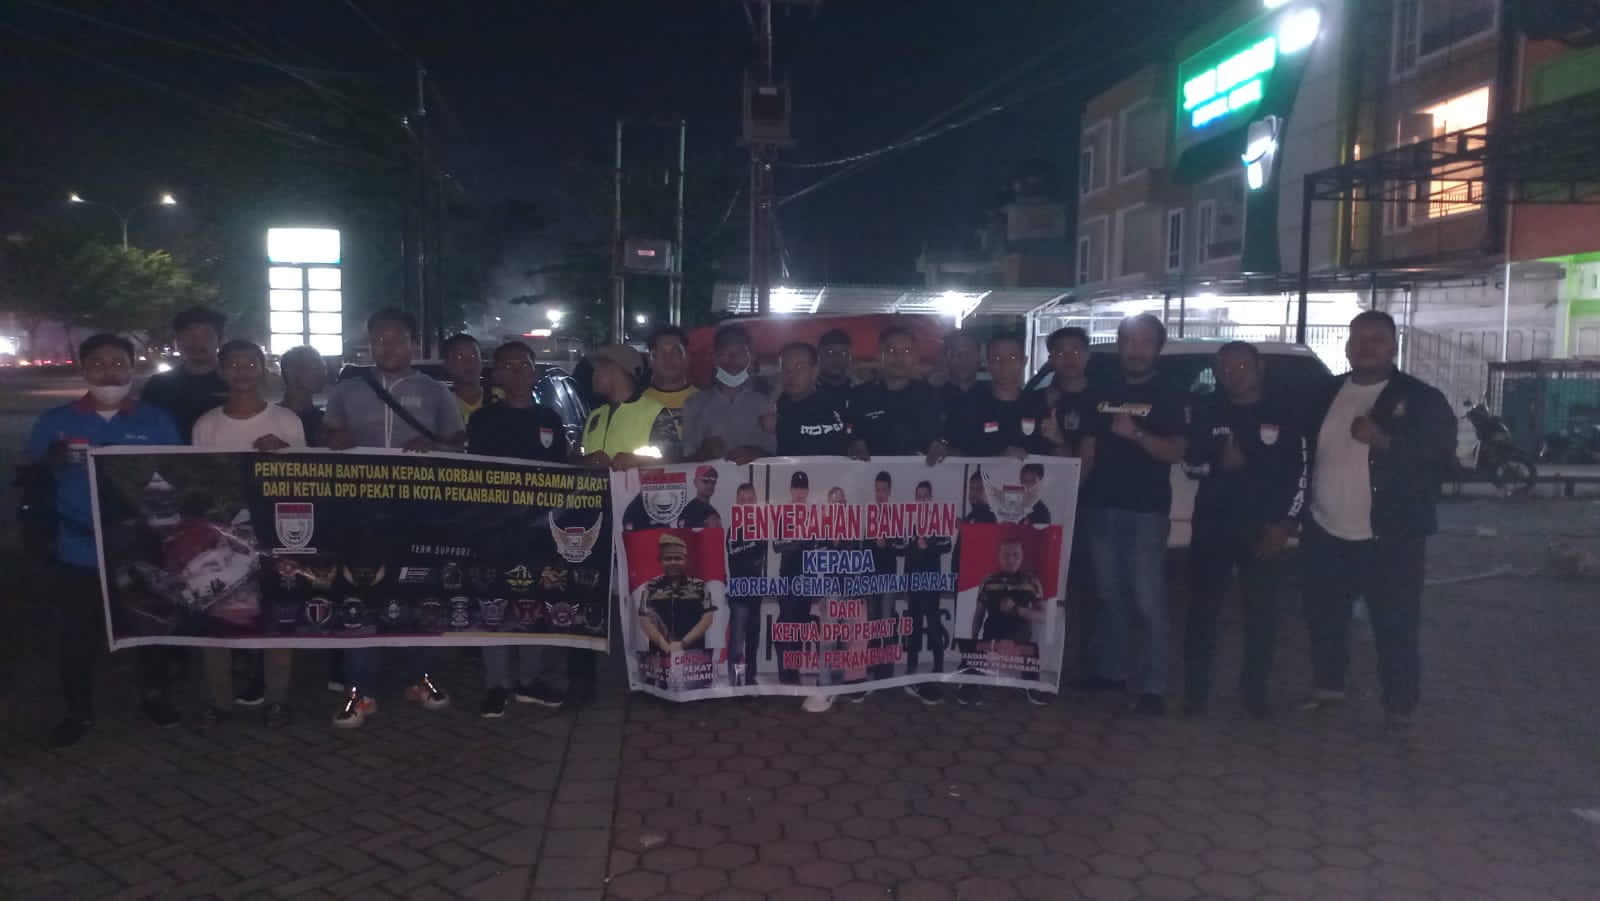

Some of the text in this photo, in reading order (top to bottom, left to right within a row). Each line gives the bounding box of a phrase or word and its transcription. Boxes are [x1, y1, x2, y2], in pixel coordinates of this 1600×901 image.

[255, 462, 609, 491] PENYERAHAN BANTUAN KEPADA KORBAN GEMPA PASAMAN BARAT
[263, 481, 602, 510] DARI KETUA DPD PEKAT IB KOTA PEKANBARU DAN CLUB MOTOR
[729, 502, 956, 541] PENYERAHAN BANTUAN
[410, 544, 472, 558] TEAM SUPPORT
[803, 549, 875, 574] KEPADA
[728, 571, 958, 597] KORBAN GEMPA PASAMAN BARAT
[829, 600, 860, 618] DARI
[772, 616, 914, 642] KETUA DPD PEKAT IB
[784, 649, 820, 669] KOTA
